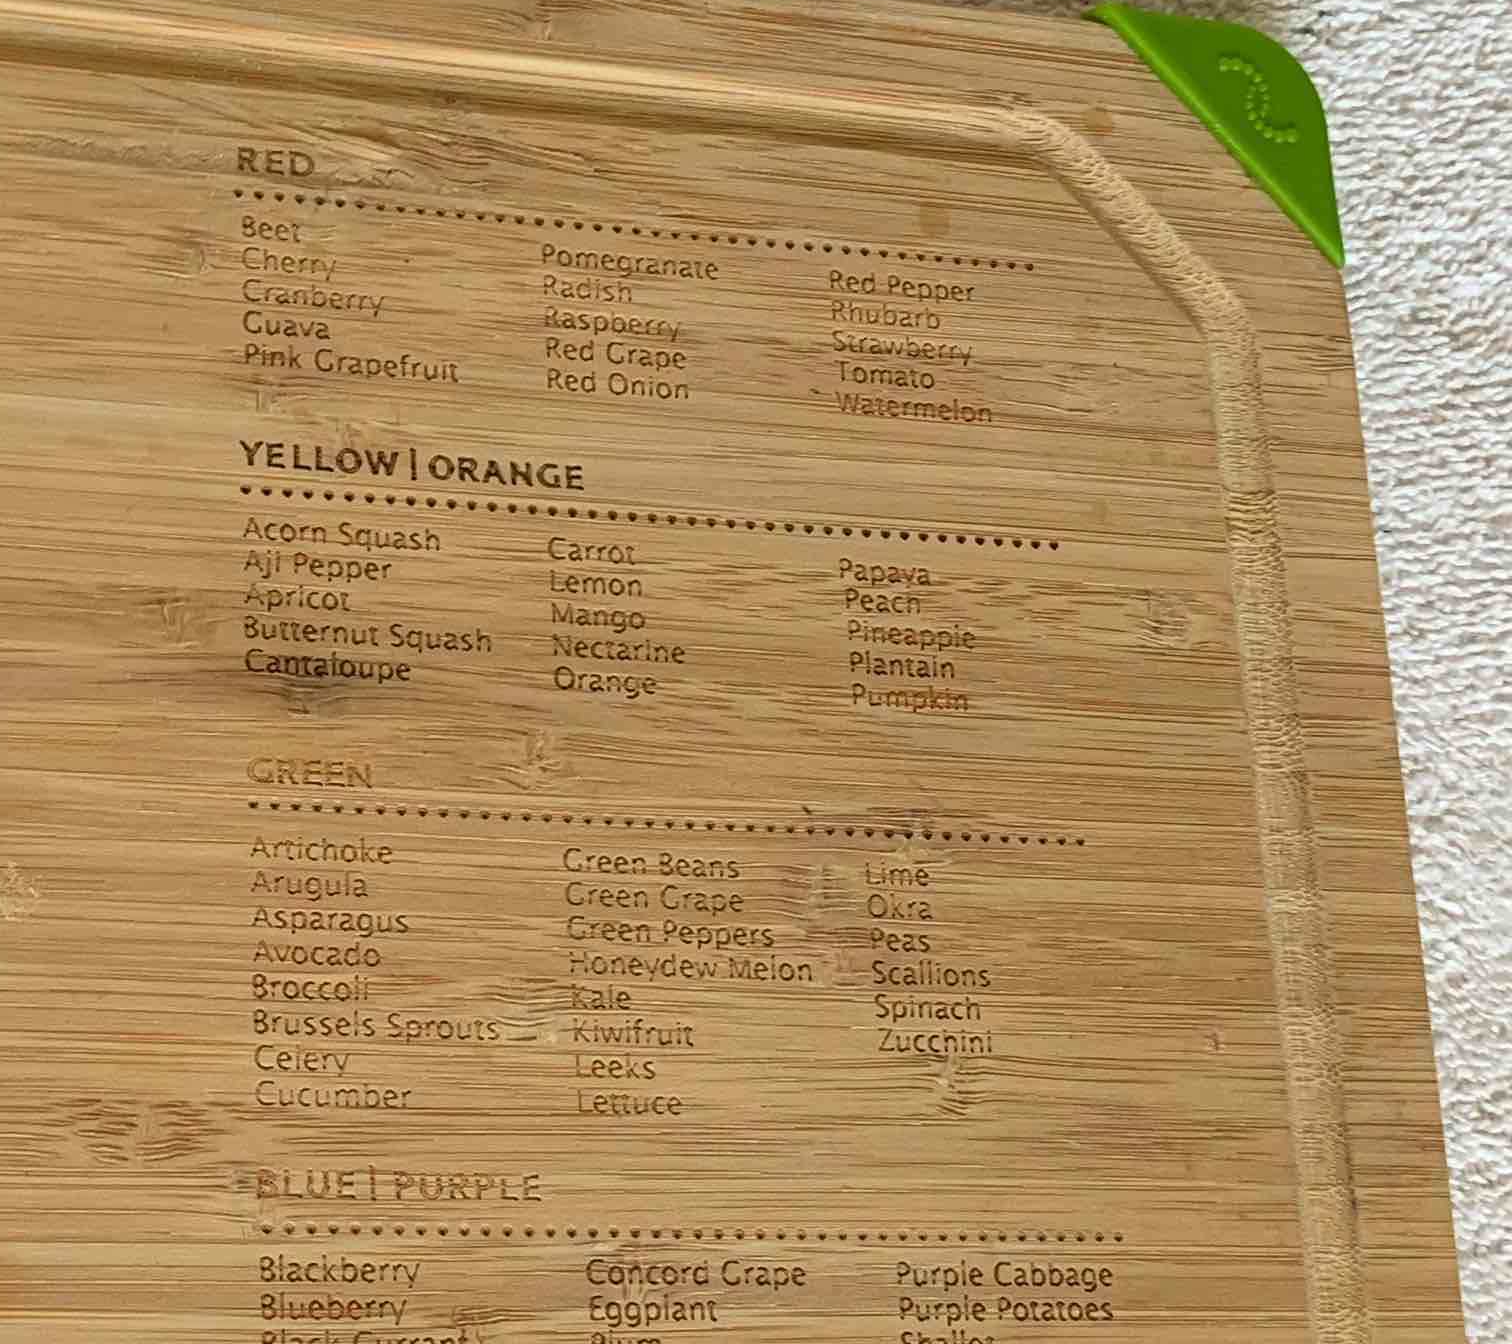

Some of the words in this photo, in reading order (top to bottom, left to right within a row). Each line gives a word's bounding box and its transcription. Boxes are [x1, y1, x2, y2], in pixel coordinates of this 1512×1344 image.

[236, 147, 315, 178] RED
[241, 215, 302, 242] Beet
[241, 246, 337, 280] Cherry
[542, 243, 719, 281] Pomegranate
[242, 279, 387, 316] Cranberry
[543, 274, 633, 304] Radish
[828, 270, 875, 294] Red
[887, 274, 975, 304] Pepper
[242, 310, 331, 340] Guava
[544, 306, 681, 342] Raspberry
[831, 300, 941, 331] Rhubarb
[243, 343, 302, 369] Pink
[314, 348, 459, 383] Grapefruit
[545, 337, 594, 361] Red
[606, 341, 686, 371] Grape
[832, 330, 973, 365] Strawberry
[546, 368, 596, 393] Red
[608, 373, 690, 400] Onion
[836, 360, 936, 390] Tomato
[835, 391, 993, 423] Watermelon
[242, 517, 327, 542] Acorn
[338, 522, 441, 552] Squash
[243, 549, 282, 579] Aji
[293, 553, 392, 583] Pepper
[547, 536, 637, 566] Carrot
[549, 570, 643, 597] Lemon
[838, 558, 931, 588] Papaya
[243, 583, 351, 613] Apricot
[844, 588, 922, 615] Peach
[551, 602, 646, 633] Mango
[244, 616, 379, 647] Butternut
[390, 623, 492, 654] Squash
[552, 633, 686, 663] Nectarine
[847, 619, 977, 652] Pineapple
[244, 648, 412, 684] Cantaloupe
[850, 651, 955, 680] Plantain
[553, 666, 658, 699] Orange
[851, 684, 969, 713] Pumpkin
[247, 758, 372, 788] GREEN
[250, 836, 393, 865] Artichoke
[563, 848, 646, 875] Green
[659, 852, 741, 880] Beans
[250, 870, 368, 901] Arugula
[864, 862, 930, 888] Lime
[564, 881, 649, 910] Green
[660, 885, 744, 917] Grape
[867, 893, 934, 920] Okra
[251, 906, 409, 938] Asparagus
[567, 916, 651, 944] Green
[664, 920, 775, 949] Peppers
[252, 939, 383, 967] Avocado
[869, 927, 931, 953] Peas
[569, 950, 718, 982] Honeydew
[728, 956, 814, 983] Melon
[871, 959, 991, 989] Scallions
[251, 972, 370, 1003] Broccoli
[571, 983, 632, 1011] Kale
[874, 994, 982, 1024] Spinach
[252, 1008, 376, 1038] Brussels
[387, 1012, 500, 1044] Sprouts
[572, 1018, 694, 1049] Kiwifruit
[878, 1027, 993, 1054] Zucchini
[254, 1044, 349, 1077] Celery
[575, 1052, 656, 1080] Leeks
[255, 1080, 413, 1109] Cucumber
[578, 1088, 683, 1117] Lettuce
[258, 1254, 421, 1289] Blackberry
[586, 1259, 710, 1288] Concord
[721, 1261, 807, 1291] Grape
[896, 1260, 983, 1291] Purple
[994, 1260, 1114, 1292] Cabbage
[260, 1292, 408, 1325] Blueberry
[590, 1295, 718, 1325] Eggplant
[899, 1294, 986, 1325] Purple
[997, 1295, 1114, 1323] Potatoes
